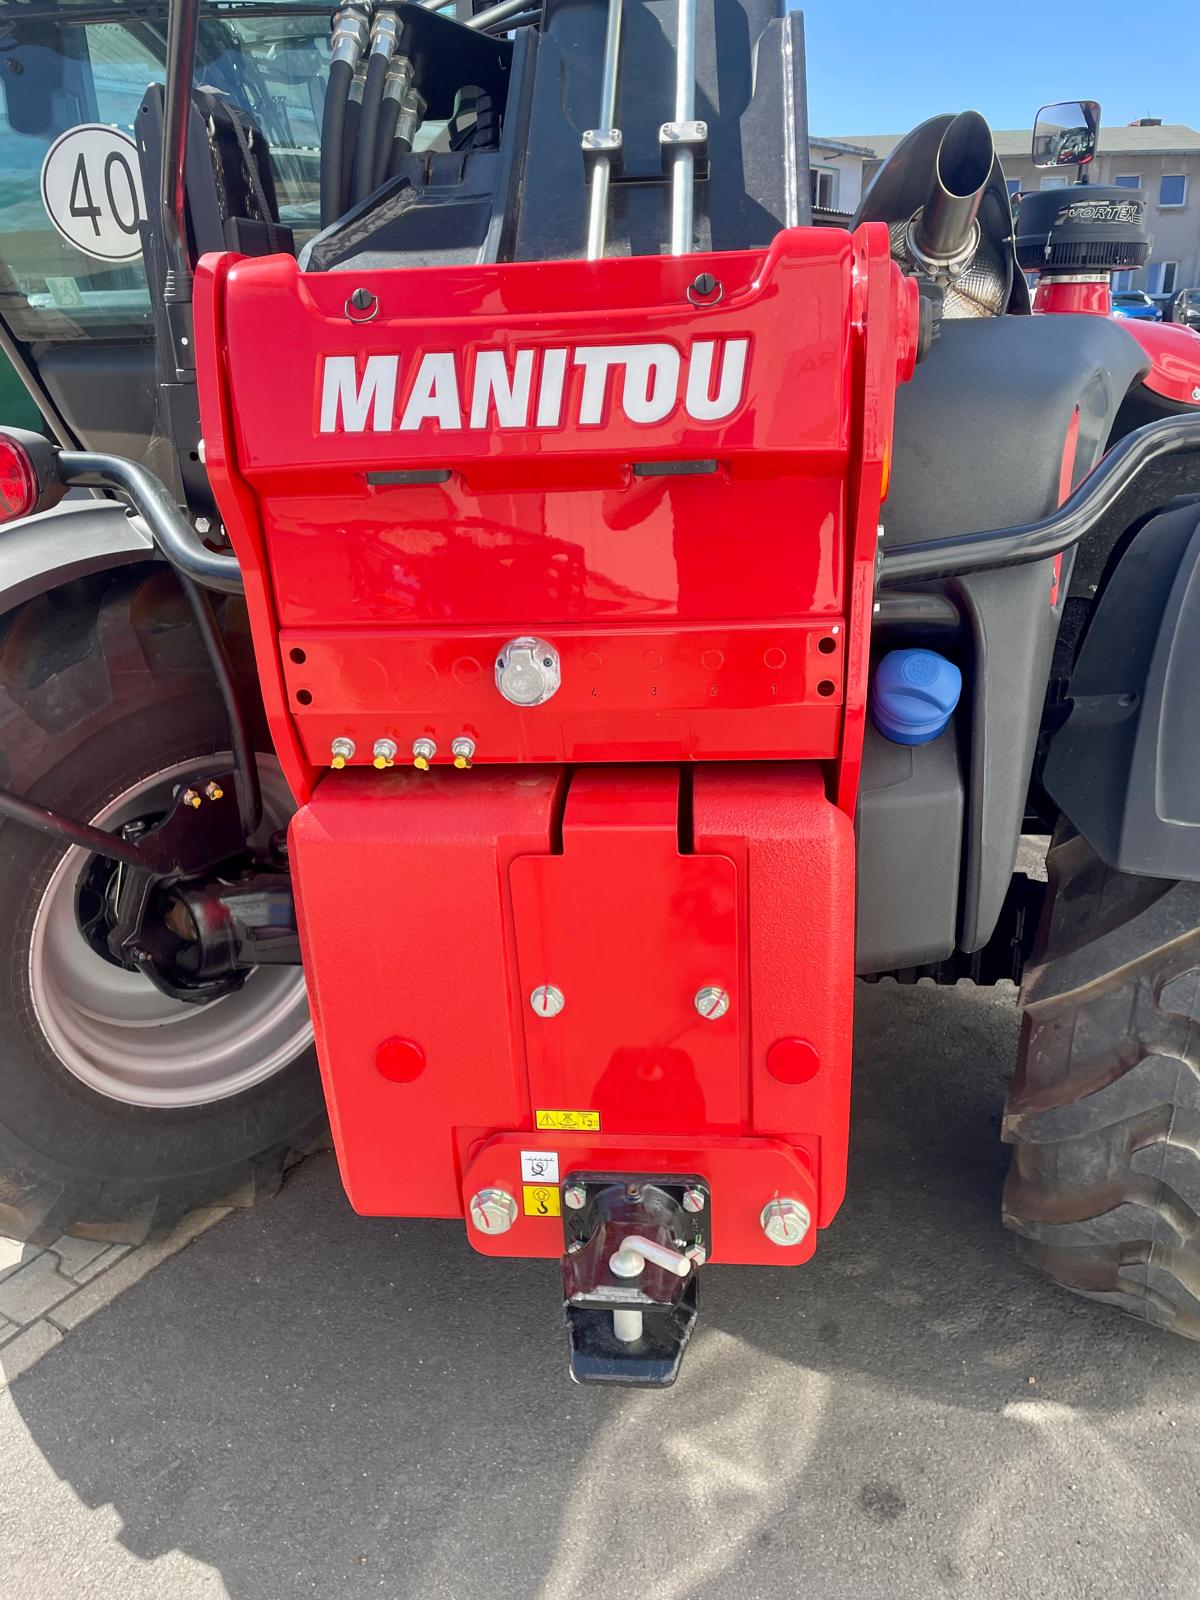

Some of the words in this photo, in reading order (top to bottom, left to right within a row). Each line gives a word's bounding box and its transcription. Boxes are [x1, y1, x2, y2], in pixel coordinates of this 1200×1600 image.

[69, 151, 140, 236] 40
[1068, 205, 1138, 222] VORTEX
[319, 338, 750, 433] MANITOU
[651, 686, 657, 697] 3
[711, 685, 718, 695] 2
